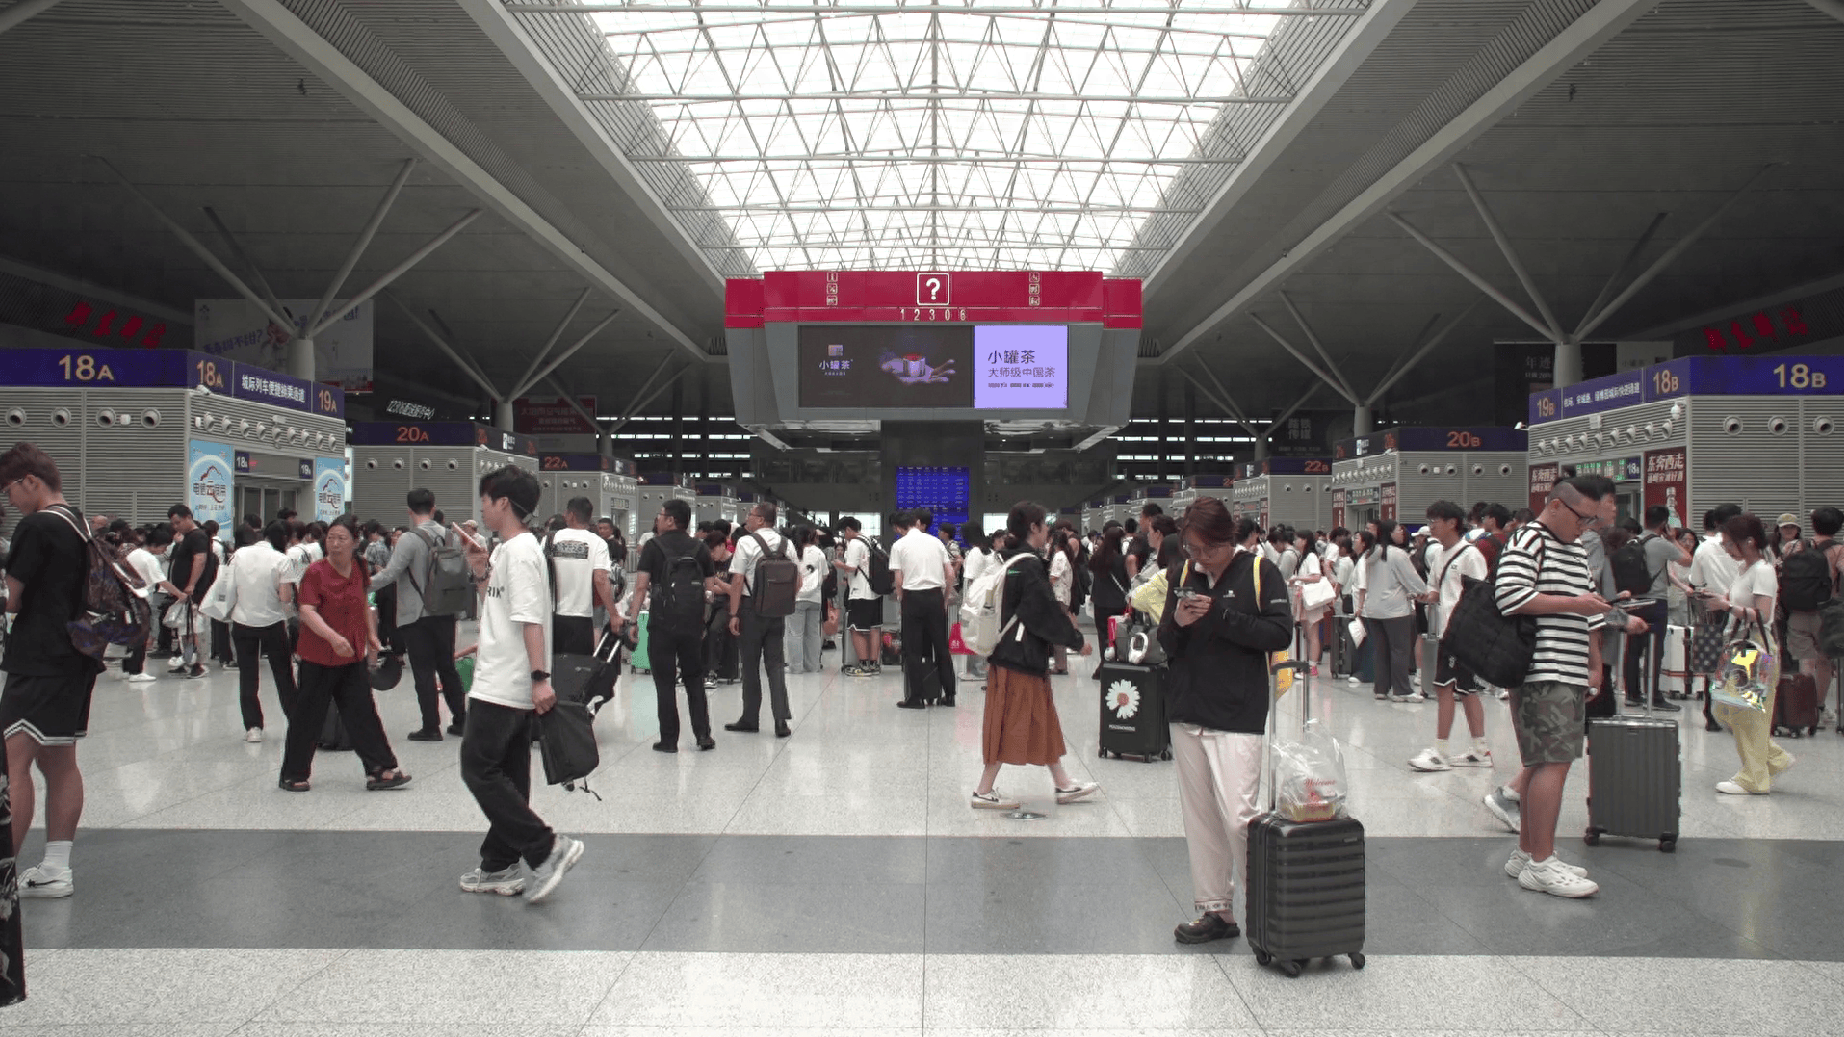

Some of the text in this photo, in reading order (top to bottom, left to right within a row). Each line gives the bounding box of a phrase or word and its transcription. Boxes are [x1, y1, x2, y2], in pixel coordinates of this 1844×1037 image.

[899, 308, 967, 322] 12306
[818, 359, 851, 371] 小罐茶
[987, 349, 1036, 365] 小罐茶
[59, 355, 115, 381] 18A
[196, 359, 224, 388] 18A
[987, 365, 1056, 379] 大师级中国茶
[1772, 364, 1827, 388] 18B
[1653, 369, 1680, 395] 18B
[318, 389, 337, 413] 19A
[1536, 397, 1556, 417] 19B
[396, 426, 430, 443] 20A
[1446, 431, 1483, 448] 20B
[544, 456, 569, 470] 22A
[1304, 460, 1330, 473] 22B
[1647, 452, 1684, 472] 东奔西走
